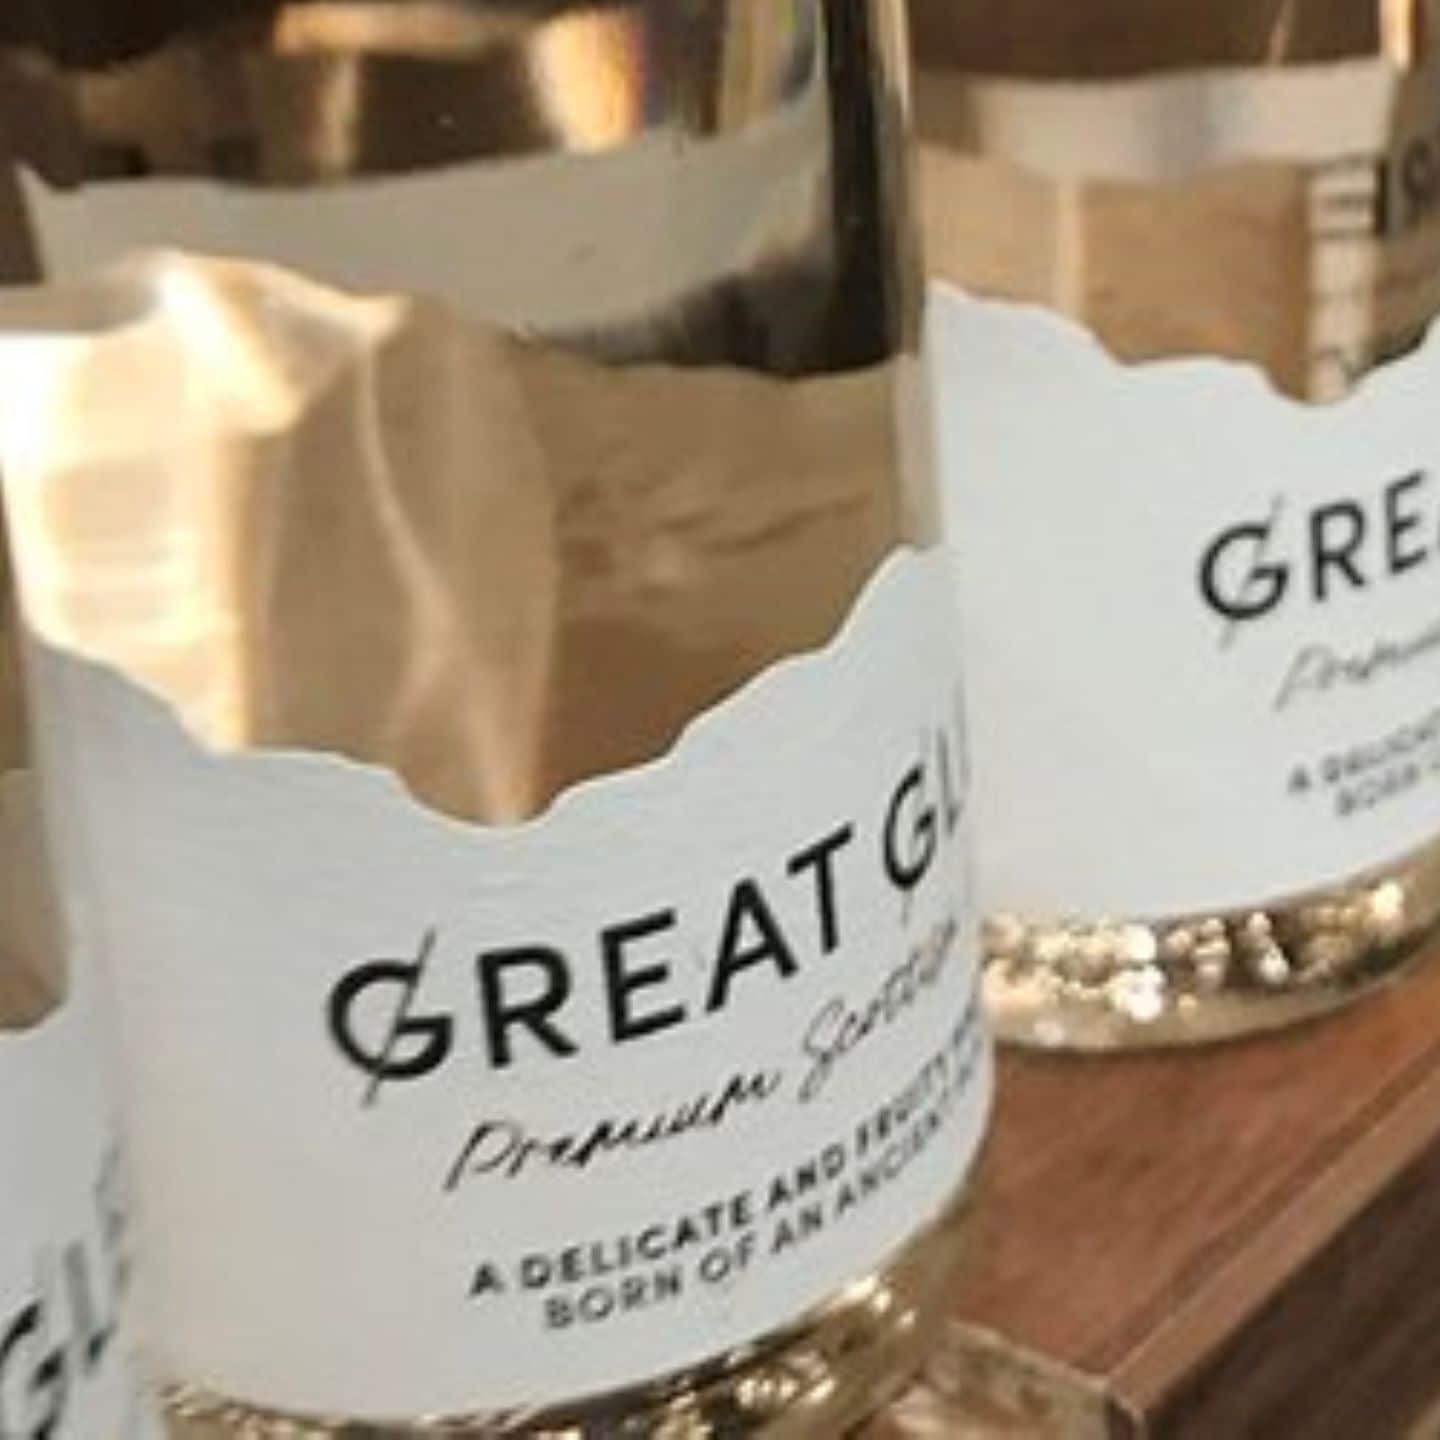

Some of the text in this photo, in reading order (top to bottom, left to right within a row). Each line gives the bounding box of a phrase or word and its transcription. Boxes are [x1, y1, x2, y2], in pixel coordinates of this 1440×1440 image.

[327, 820, 856, 1106] GREAT
[443, 1068, 782, 1193] Premium
[468, 1261, 505, 1298] A
[520, 1190, 754, 1291] DELICATE
[767, 1142, 845, 1212] AND
[543, 1271, 682, 1331] BORN
[698, 1231, 757, 1284] OF
[769, 1202, 824, 1254] AN
